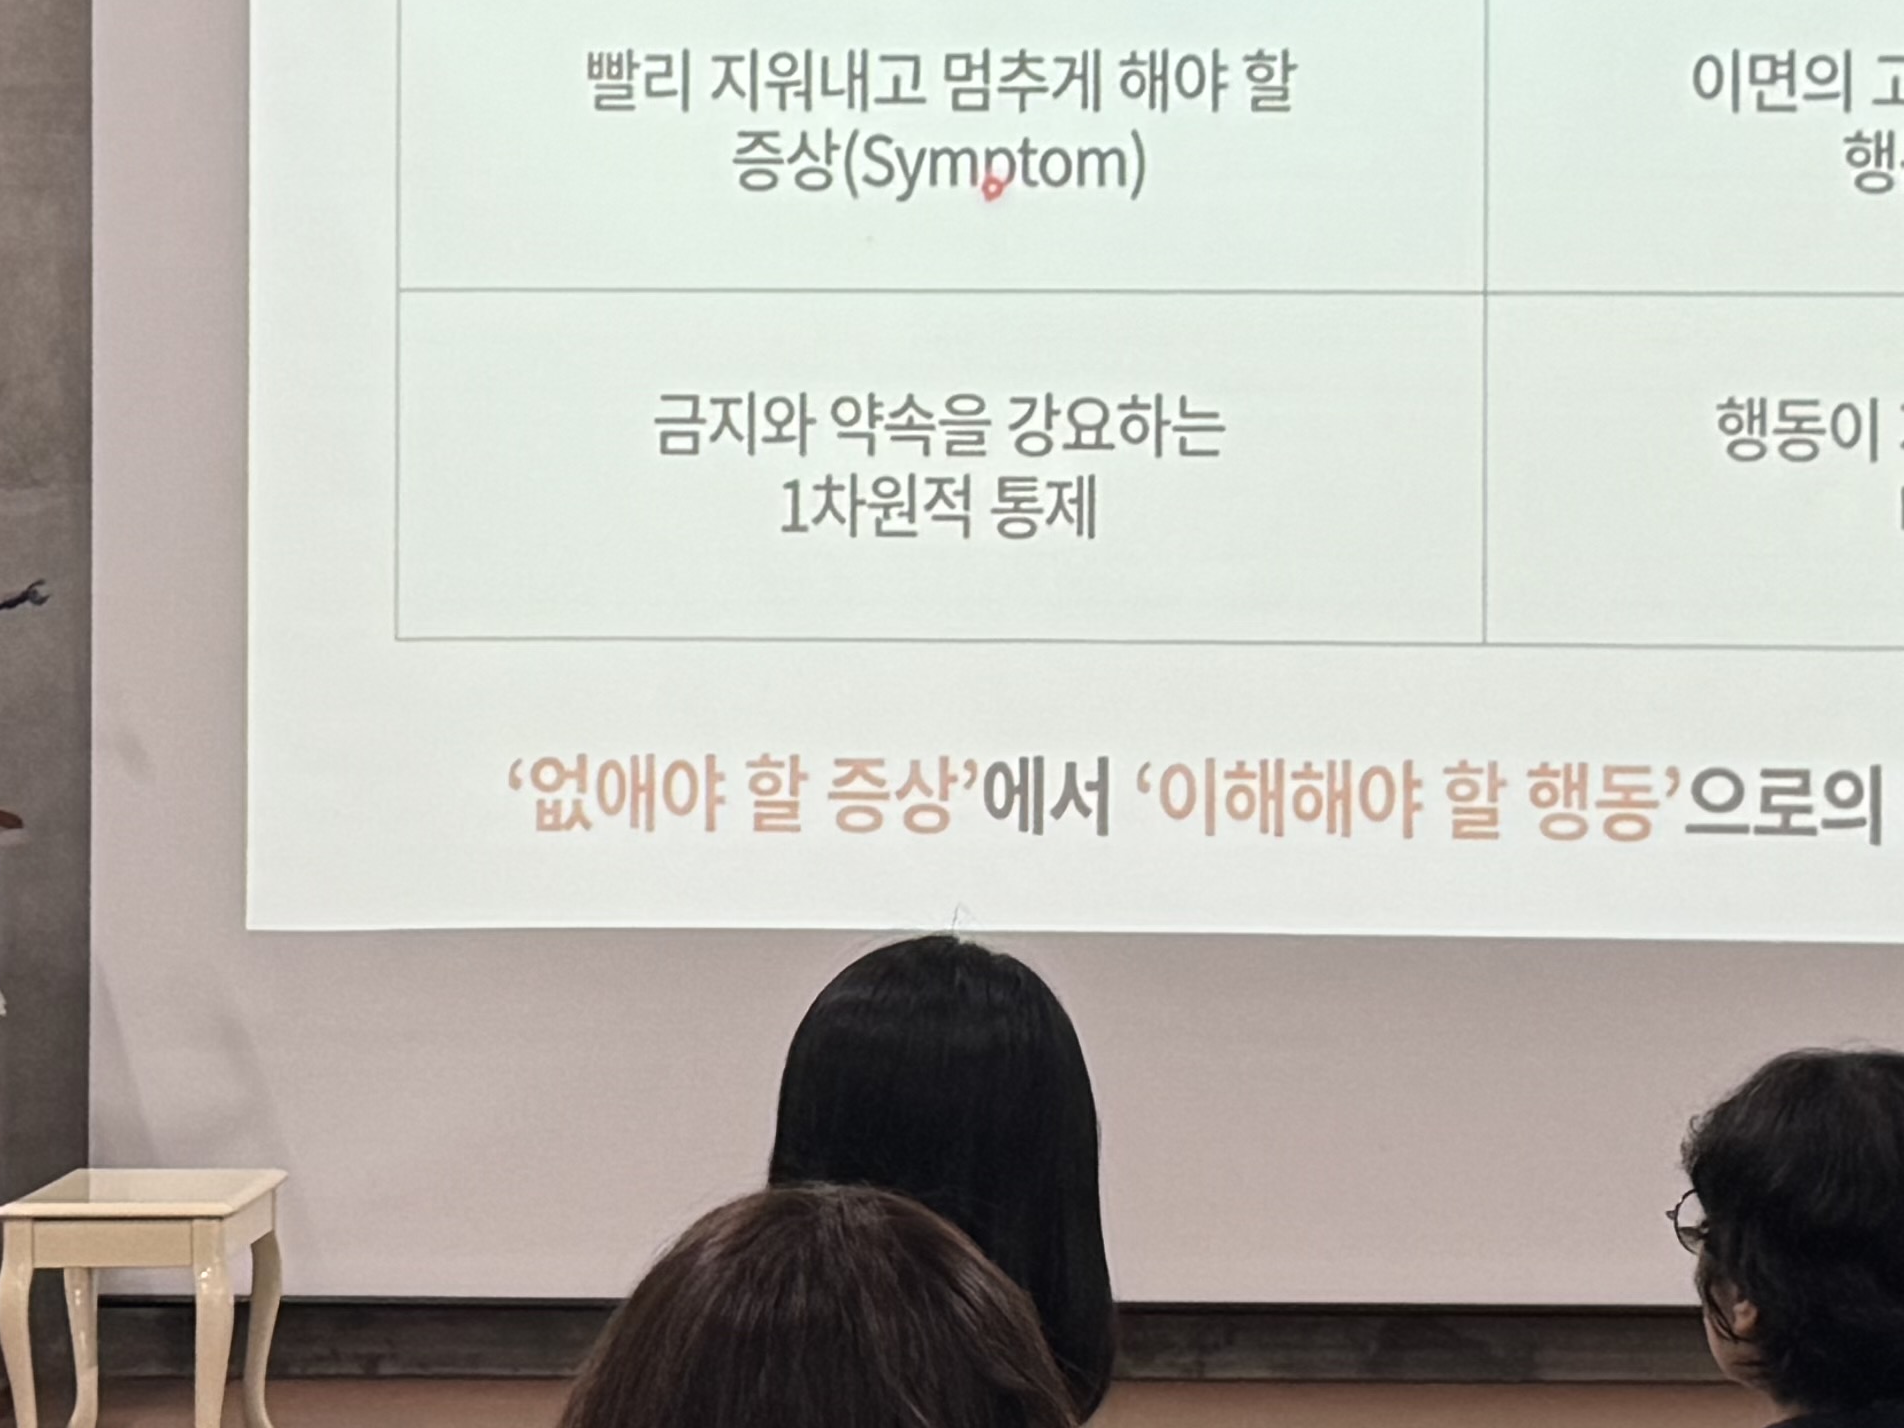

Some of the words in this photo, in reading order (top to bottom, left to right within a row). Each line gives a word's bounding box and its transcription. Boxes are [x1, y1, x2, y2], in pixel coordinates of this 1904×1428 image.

[587, 48, 690, 113] 빨리
[711, 48, 927, 113] 지워내고
[944, 47, 1101, 114] 멈추게
[1119, 48, 1229, 113] 해야
[1242, 48, 1298, 113] 할
[1693, 48, 1852, 114] 이면의
[732, 127, 1147, 203] 증상(Symptom)
[654, 391, 817, 458] 금지와
[830, 392, 992, 457] 약속을
[1008, 392, 1226, 459] 강요하는
[1716, 396, 1878, 463] 행동이
[781, 472, 971, 540] 1차원적
[990, 474, 1096, 540] 통제
[509, 753, 726, 833] ‘없애야
[745, 753, 809, 833] 할
[827, 755, 1110, 838] 증상’에서
[1137, 757, 1424, 841] ‘이해해야
[1443, 759, 1508, 840] 할
[1526, 762, 1883, 847] 행동’으로의
